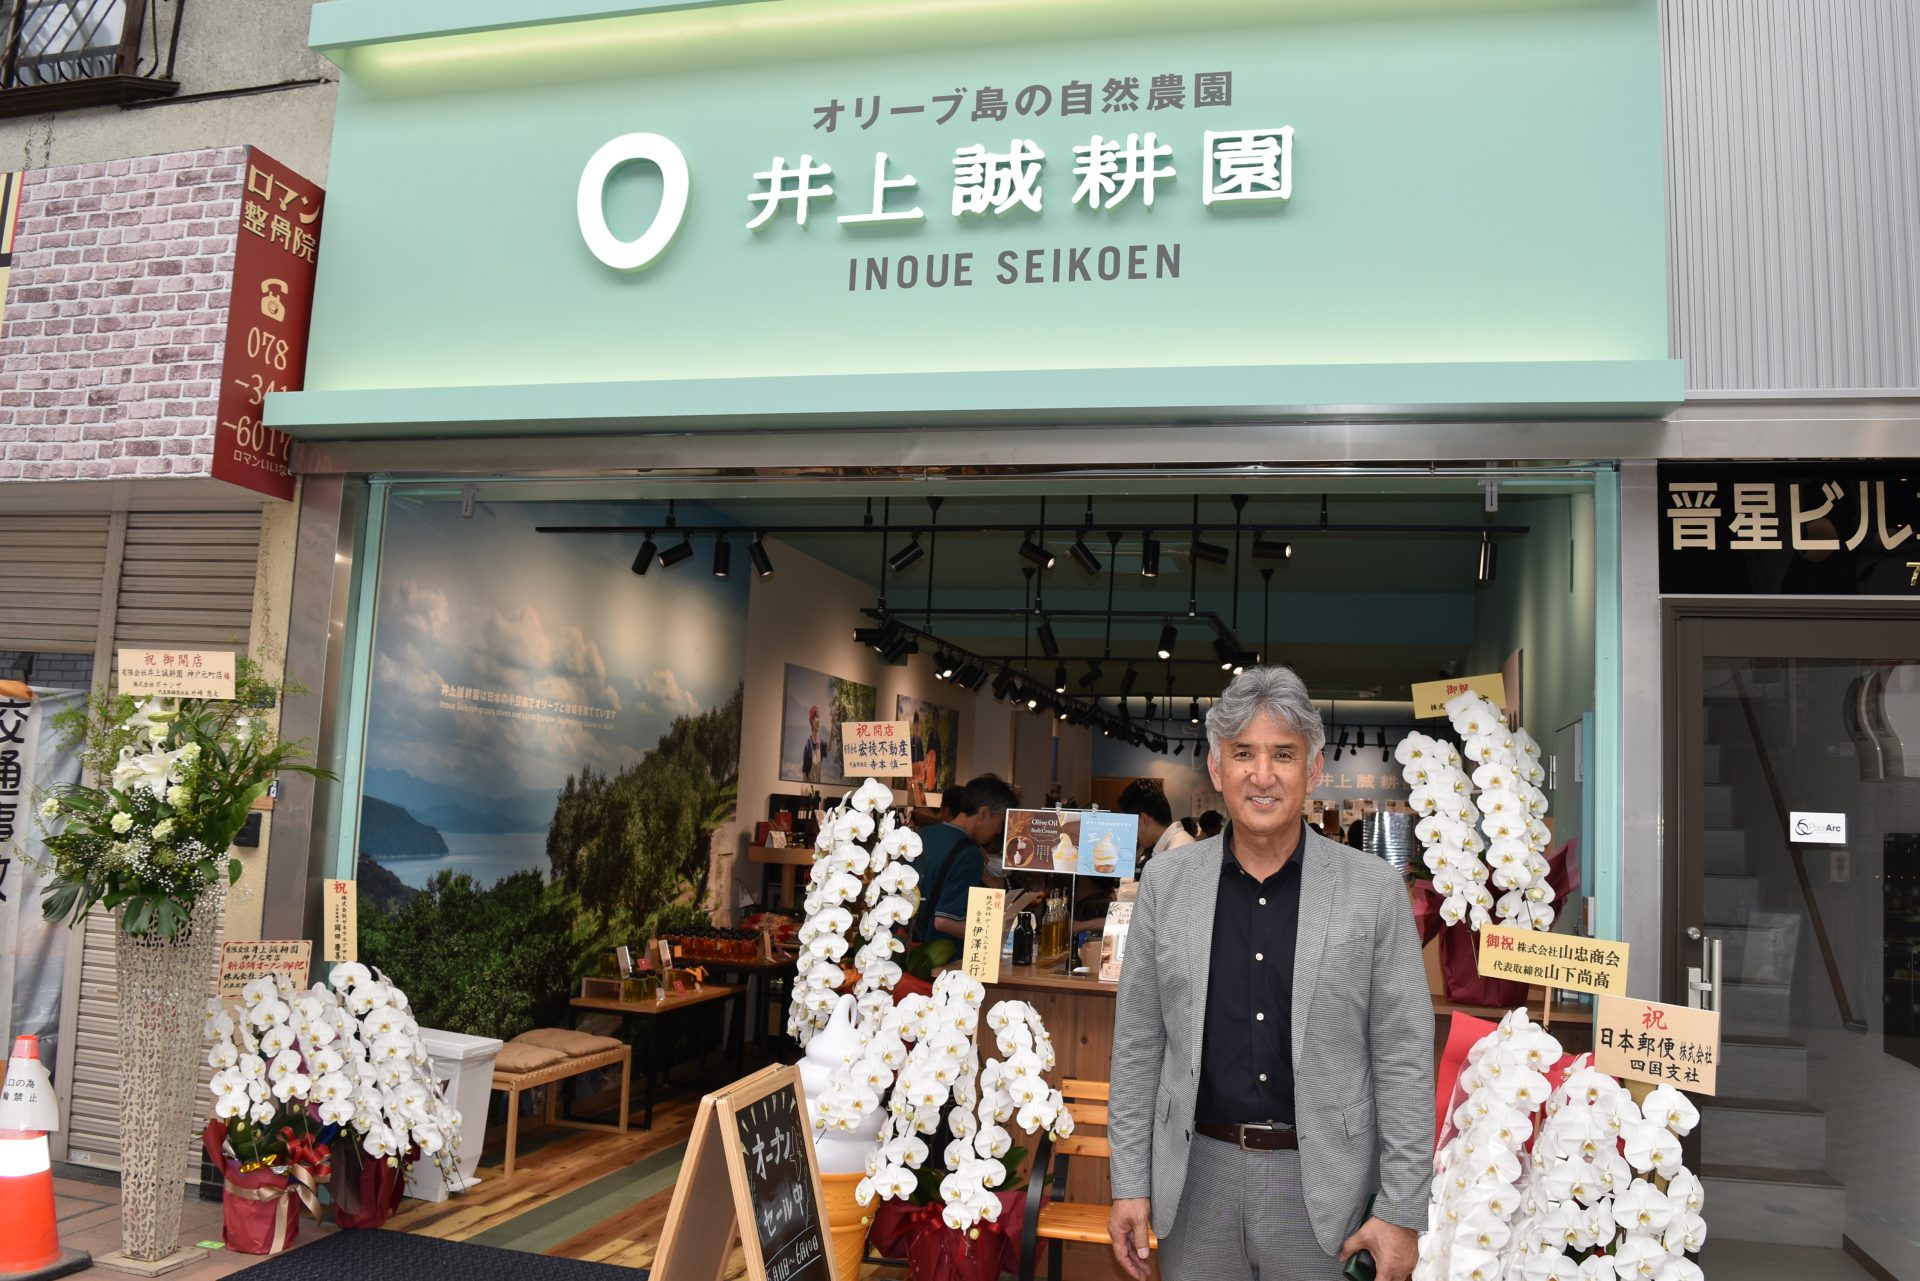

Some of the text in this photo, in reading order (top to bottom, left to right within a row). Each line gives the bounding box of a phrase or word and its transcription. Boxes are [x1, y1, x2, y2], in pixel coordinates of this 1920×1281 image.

[812, 71, 1232, 132] オリーブ島の自然農園
[248, 164, 320, 224] ロマン
[746, 125, 1294, 232] 井上誠耕園
[243, 201, 316, 263] 整骨院
[848, 243, 1181, 291] INOUE SEIKOEN
[247, 327, 289, 370] 078
[1667, 480, 1920, 551] 晋星ビル
[1318, 773, 1412, 791] 井上誠耕
[333, 881, 348, 894] 祝
[1486, 933, 1514, 951] 御祝
[1642, 1006, 1668, 1030] 祝
[1600, 1027, 1676, 1061] 日本郵便
[1630, 1059, 1700, 1083] 四国支社
